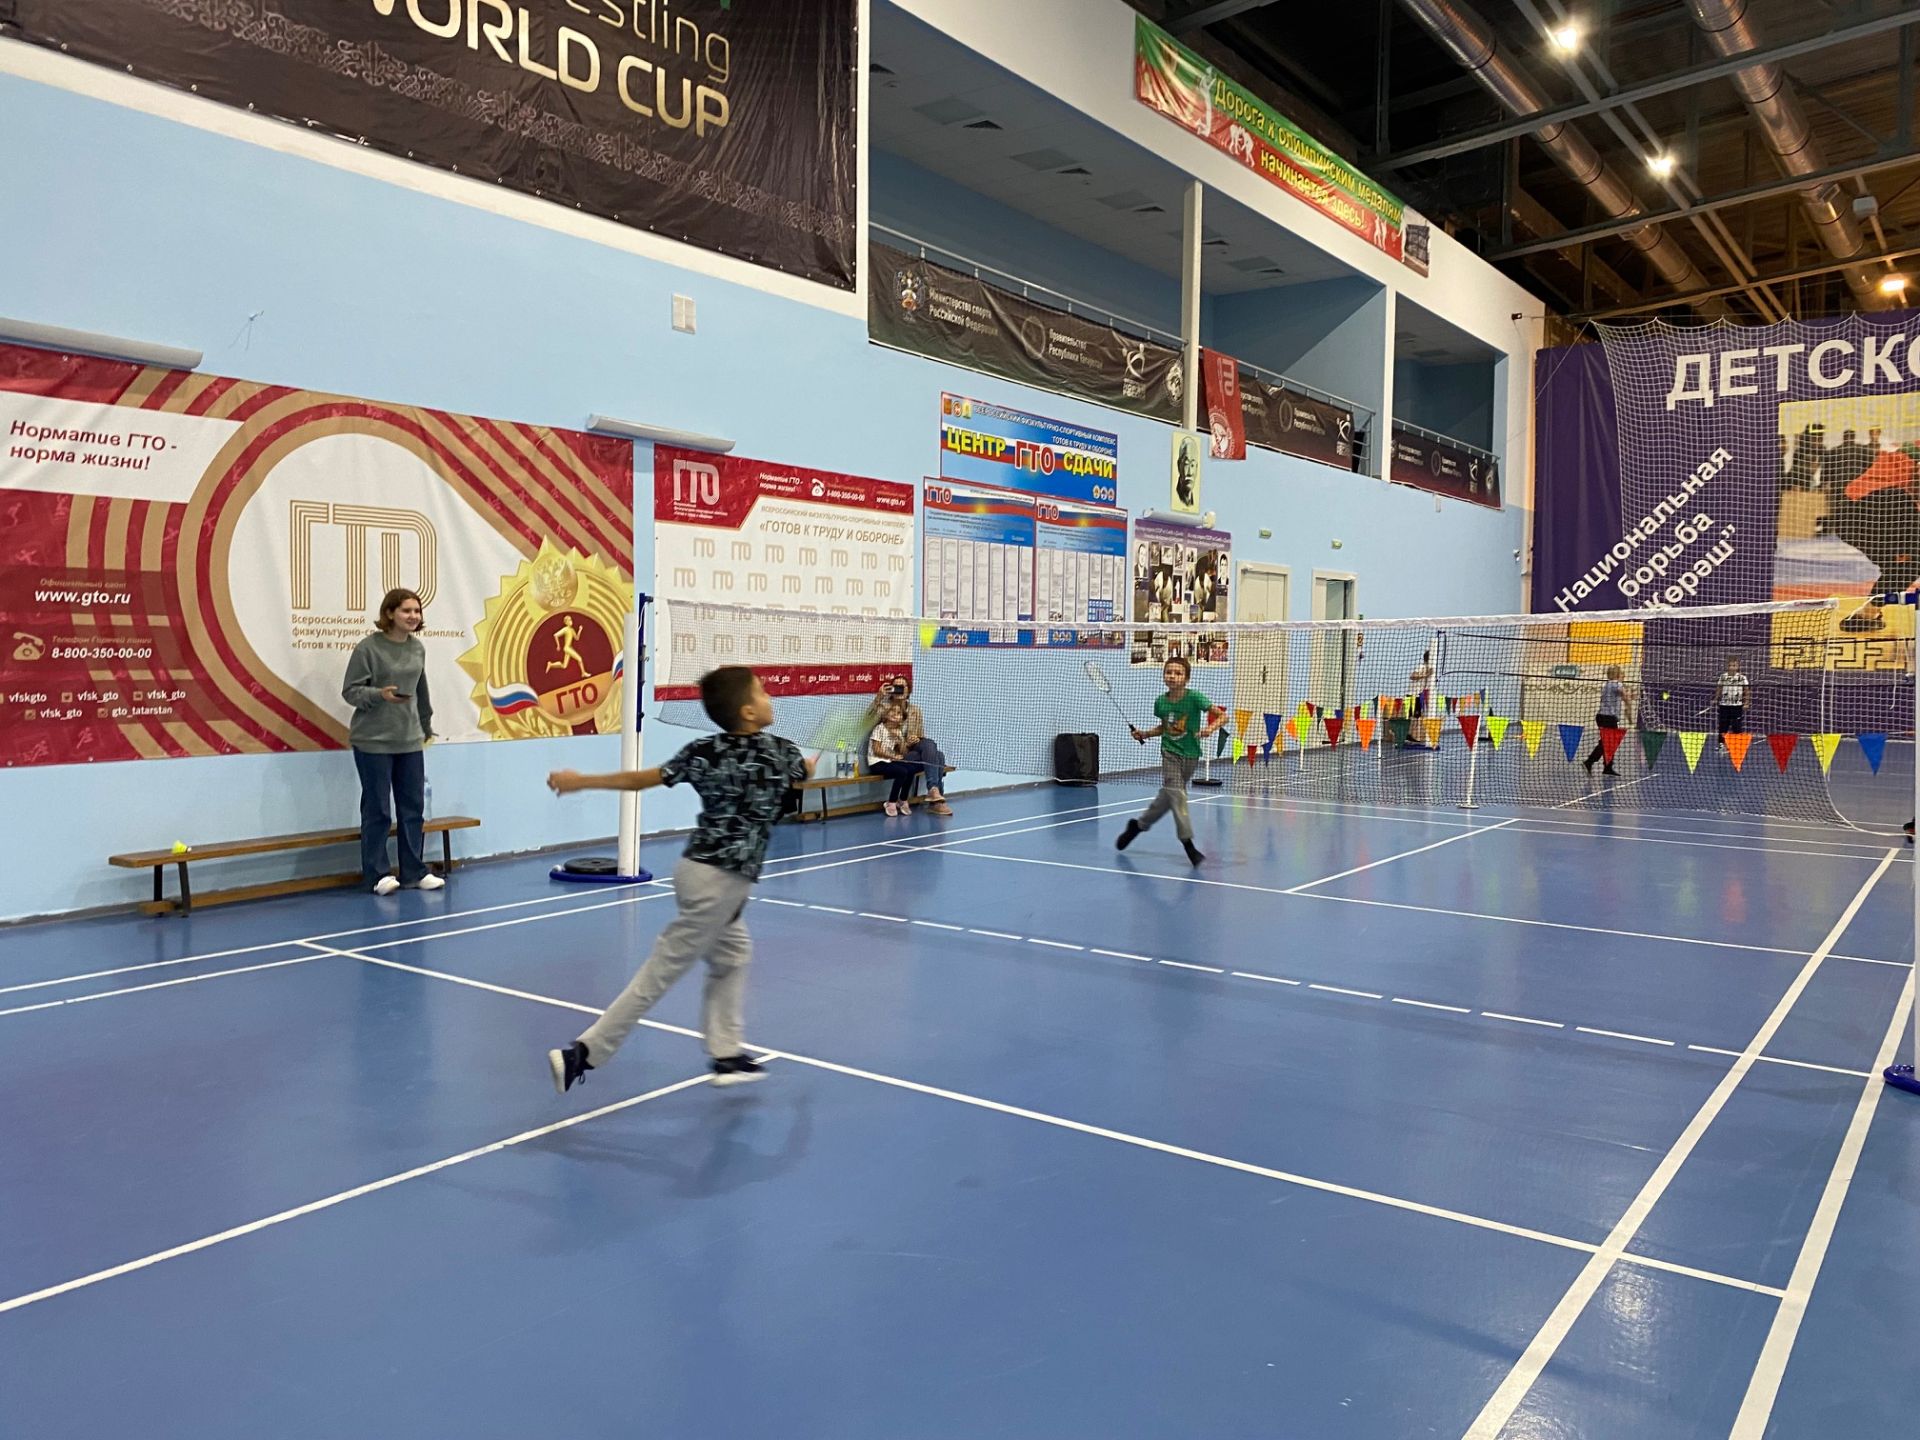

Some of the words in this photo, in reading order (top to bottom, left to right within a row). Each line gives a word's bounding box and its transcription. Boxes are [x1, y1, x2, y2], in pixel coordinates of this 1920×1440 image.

[565, 0, 729, 84] stling
[373, 0, 600, 93] ORLD
[618, 55, 730, 138] CUP
[1215, 79, 1265, 132] Дорога
[1268, 121, 1275, 139] к
[1278, 127, 1355, 192] олимпийским
[1358, 181, 1401, 222] медалям
[1261, 150, 1329, 204] начинается
[1328, 195, 1365, 229] здесь!
[929, 304, 964, 326] Российской
[1666, 333, 1920, 411] ДЕТСК
[10, 420, 121, 446] Норматив
[127, 433, 166, 451] ГТО
[10, 446, 75, 464] норма
[82, 452, 150, 470] жизни!
[947, 427, 1006, 457] ЦЕНТР
[1015, 440, 1055, 475] ГТО
[1063, 452, 1113, 478] СДАЧИ
[673, 459, 720, 506] ГТО
[927, 485, 952, 505] ГТО
[1037, 503, 1059, 521] ГТО
[760, 520, 801, 535] «ГОТОВ
[804, 524, 810, 536] К
[813, 525, 844, 541] ТРУДУ
[847, 529, 853, 540] И
[855, 530, 904, 545] ОБОРОНЕ»
[1553, 446, 1733, 613] Национальная
[290, 500, 437, 611] ГТО
[694, 538, 715, 558] ГТО
[731, 541, 751, 560] ГТО
[765, 544, 784, 563] ГТО
[799, 547, 817, 566] ГТО
[831, 549, 848, 567] ГТО
[861, 552, 877, 570] ГТО
[888, 554, 904, 571] ГТО
[1617, 512, 1715, 597] борьба
[674, 567, 696, 588] ГТО
[712, 570, 733, 590] ГТО
[747, 573, 767, 592] ГТО
[782, 575, 801, 594] ГТО
[815, 576, 833, 594] ГТО
[846, 578, 863, 596] ГТО
[874, 580, 890, 598] ГТО
[35, 590, 131, 606] www.gto.ru
[292, 614, 365, 625] Всероссийский
[52, 647, 152, 658] 8-800-350-00-00
[292, 640, 324, 649] «Готов
[8, 692, 47, 704] vfskgto
[77, 691, 119, 703] vfsk_gto
[147, 690, 186, 702] vfsk_gto
[556, 683, 598, 714] ГТО
[40, 709, 82, 720] vfsk_gto
[112, 706, 173, 718] gto_tatarstan
